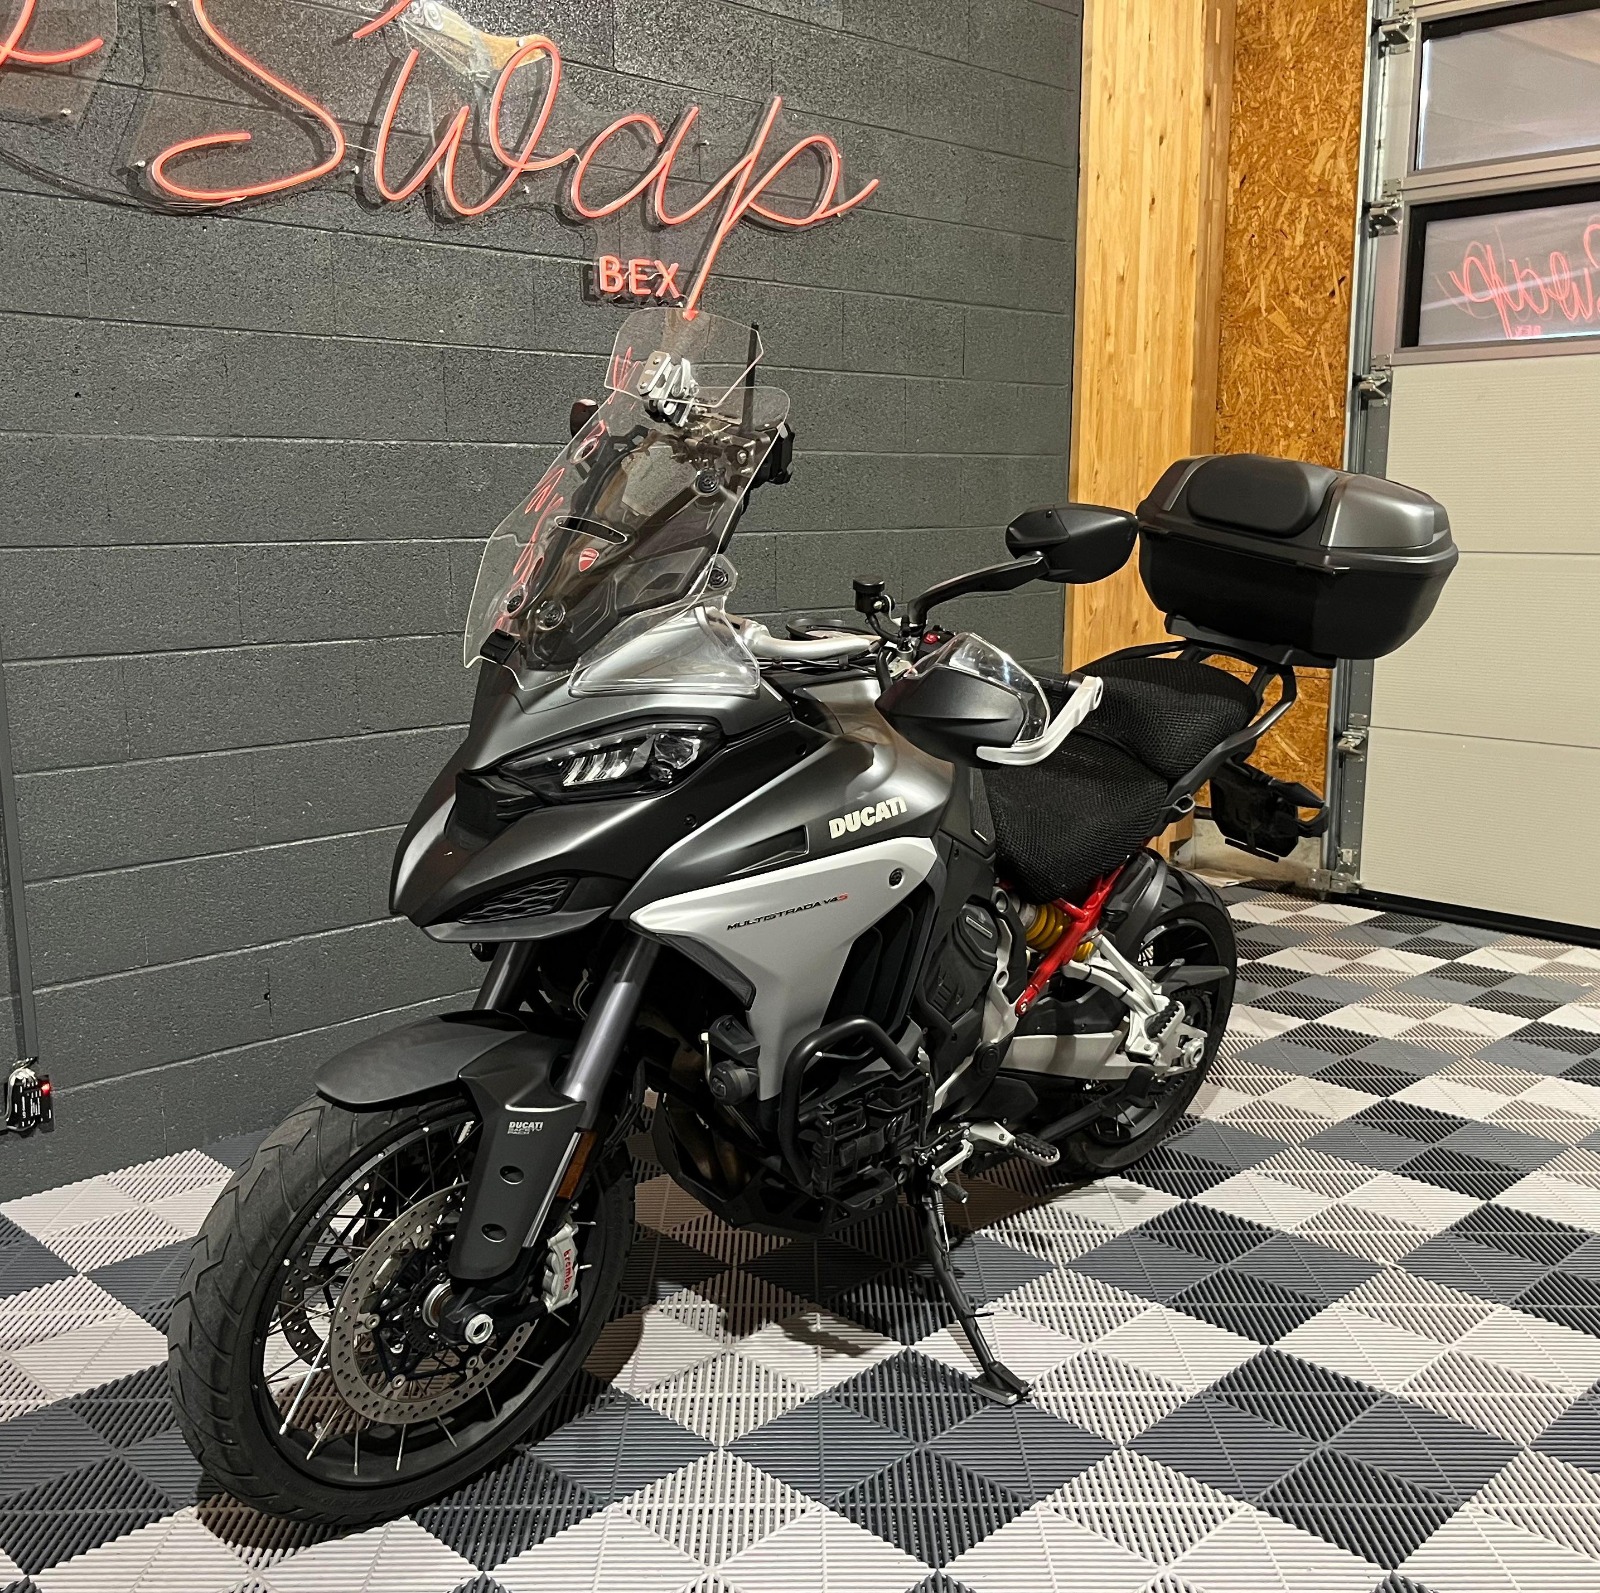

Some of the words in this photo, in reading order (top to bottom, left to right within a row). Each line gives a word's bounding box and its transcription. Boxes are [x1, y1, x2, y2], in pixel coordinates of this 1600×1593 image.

[151, 0, 878, 319] Swap
[599, 255, 680, 299] BEX
[828, 797, 907, 839] DUCATI
[727, 901, 822, 931] MULTISTRADA
[509, 1121, 544, 1129] DUCATI
[563, 1249, 573, 1291] brembo
